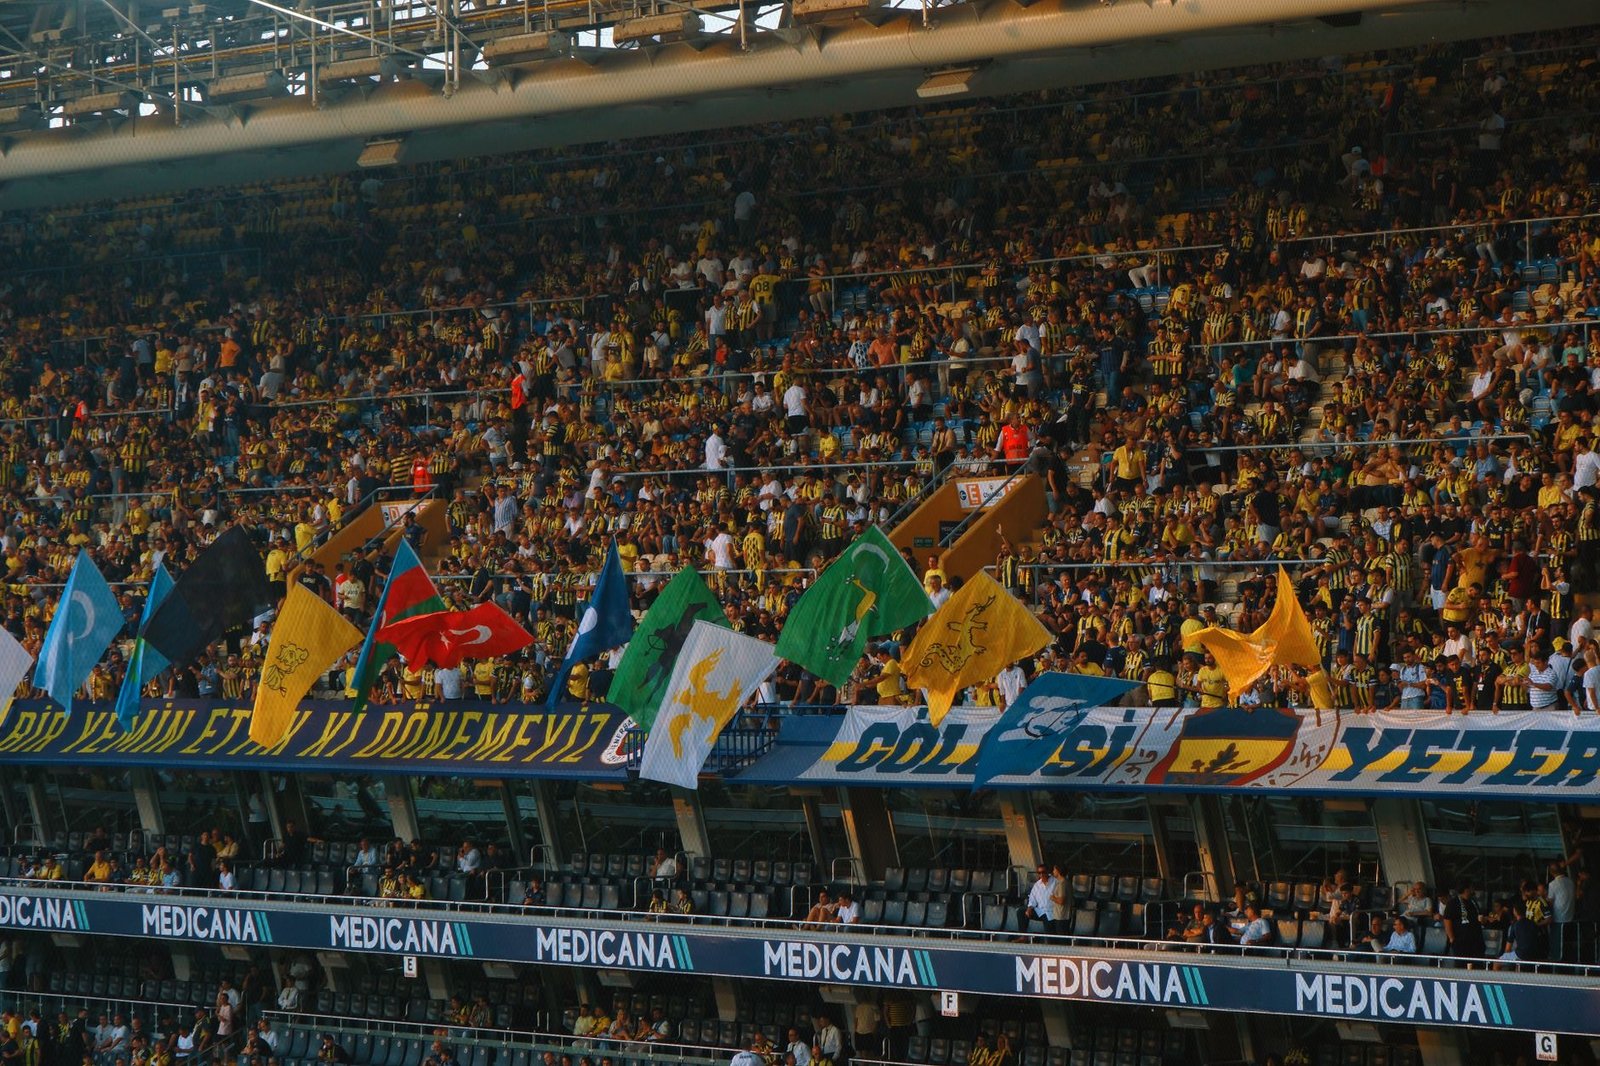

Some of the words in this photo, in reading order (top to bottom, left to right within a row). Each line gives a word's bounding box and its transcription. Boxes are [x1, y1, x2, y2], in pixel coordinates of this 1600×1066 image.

[755, 281, 770, 292] 08
[59, 702, 196, 754] YEMİN
[178, 708, 313, 757] ETK
[350, 703, 611, 763] DÖNEMEYİZ
[836, 707, 1137, 777] GÖLSİ
[1327, 726, 1600, 788] YETER
[0, 895, 76, 929] DICANA
[142, 904, 258, 942] MEDICANA
[330, 915, 457, 955] MEDICANA
[536, 927, 676, 969] MEDICANA
[407, 958, 413, 971] E
[763, 940, 918, 985] MEDICANA
[1015, 955, 1187, 1004] MEDICANA
[946, 994, 953, 1009] F
[1295, 972, 1488, 1025] MEDICANA
[1541, 1036, 1553, 1053] G
